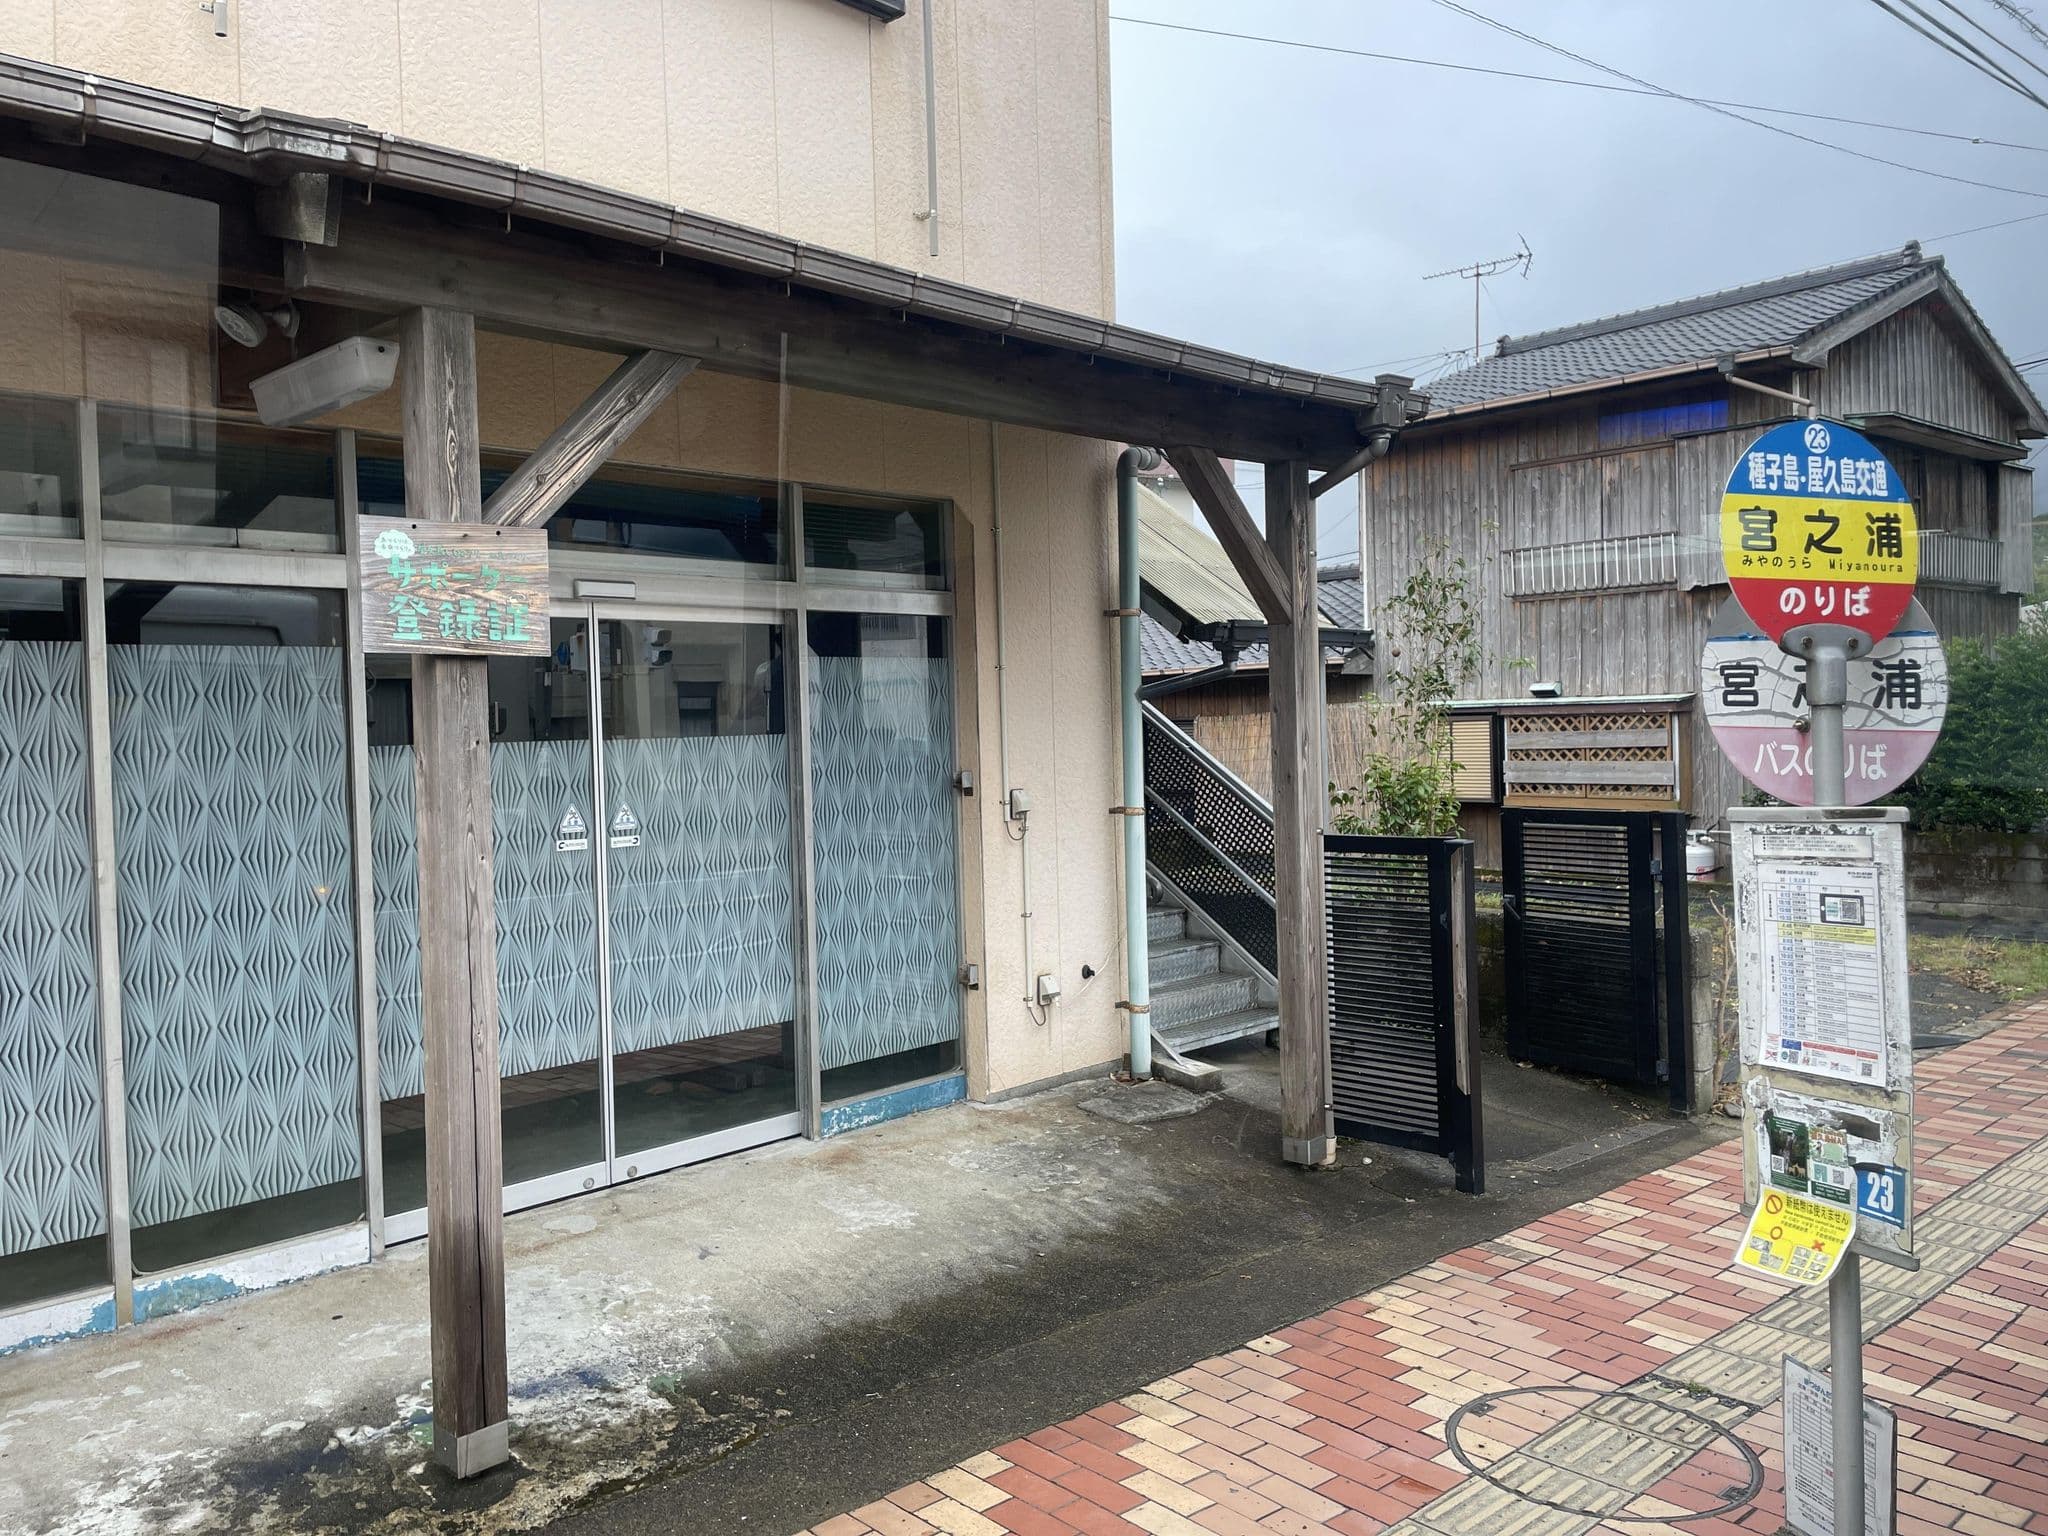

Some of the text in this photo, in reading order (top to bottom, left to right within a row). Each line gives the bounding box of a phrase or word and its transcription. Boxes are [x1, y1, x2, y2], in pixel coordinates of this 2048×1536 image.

[1738, 505, 1903, 559] 宮之浦
[387, 558, 529, 592] サポーター
[1742, 554, 1903, 572] みやのうら Miyanoura
[387, 595, 533, 642] 登録証
[1779, 585, 1871, 616] のりば
[1866, 1172, 1895, 1214] 23
